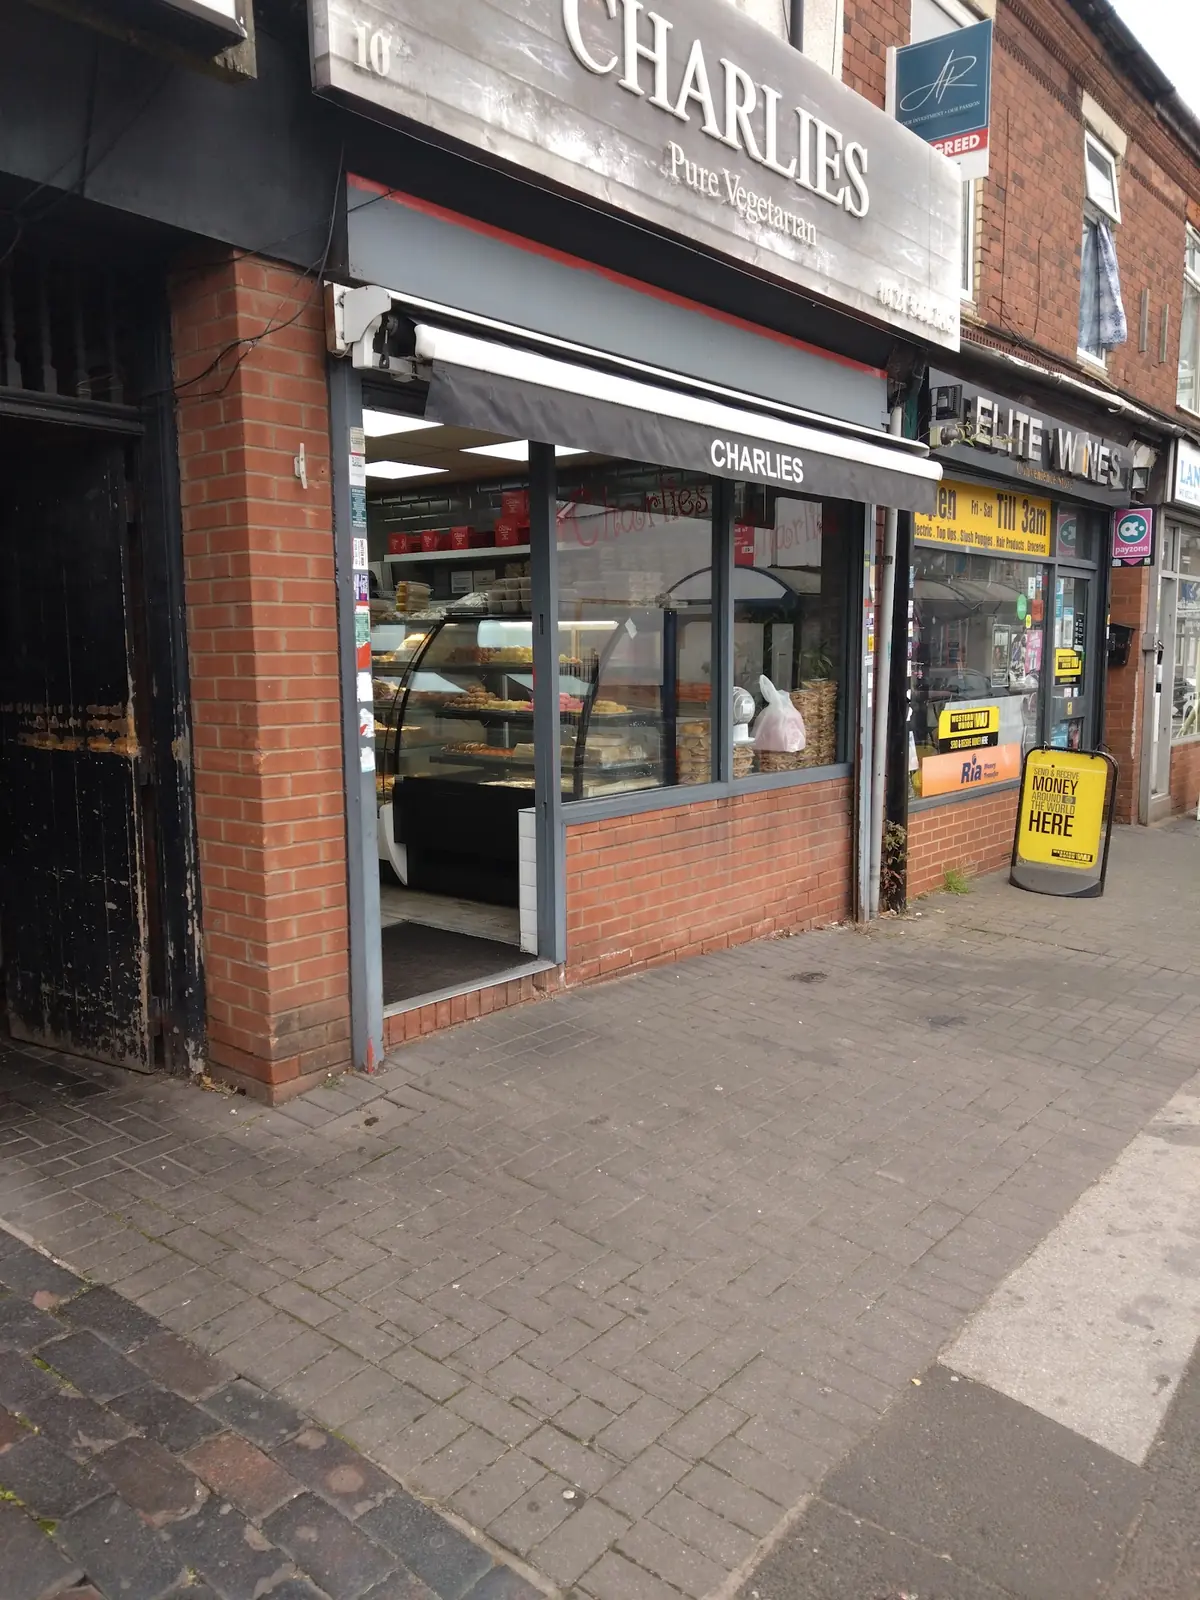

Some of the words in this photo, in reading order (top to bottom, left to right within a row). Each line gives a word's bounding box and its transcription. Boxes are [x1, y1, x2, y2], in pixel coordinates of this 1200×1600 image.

[351, 20, 392, 77] 10
[562, 0, 871, 218] CHARLIES
[934, 134, 980, 155] GREED
[667, 140, 721, 197] Pure
[722, 168, 817, 246] Vegetarian
[976, 396, 1043, 460] ELITE
[711, 439, 804, 483] CHARLIES
[1053, 428, 1127, 491] WINES
[971, 500, 979, 515] Fri
[983, 502, 993, 518] Sat
[996, 493, 1017, 531] Till
[1021, 498, 1047, 537] 3am
[915, 523, 932, 538] lectric
[1115, 545, 1148, 556] payzone
[951, 713, 973, 723] WESTERN
[960, 754, 982, 784] Ria
[1033, 768, 1049, 776] SEND
[1056, 770, 1080, 780] RECEIVE
[1031, 791, 1062, 804] AROUND
[1032, 775, 1078, 796] MONEY
[1031, 799, 1045, 811] THE
[1046, 802, 1076, 815] WORLD
[1028, 810, 1075, 837] HERE
